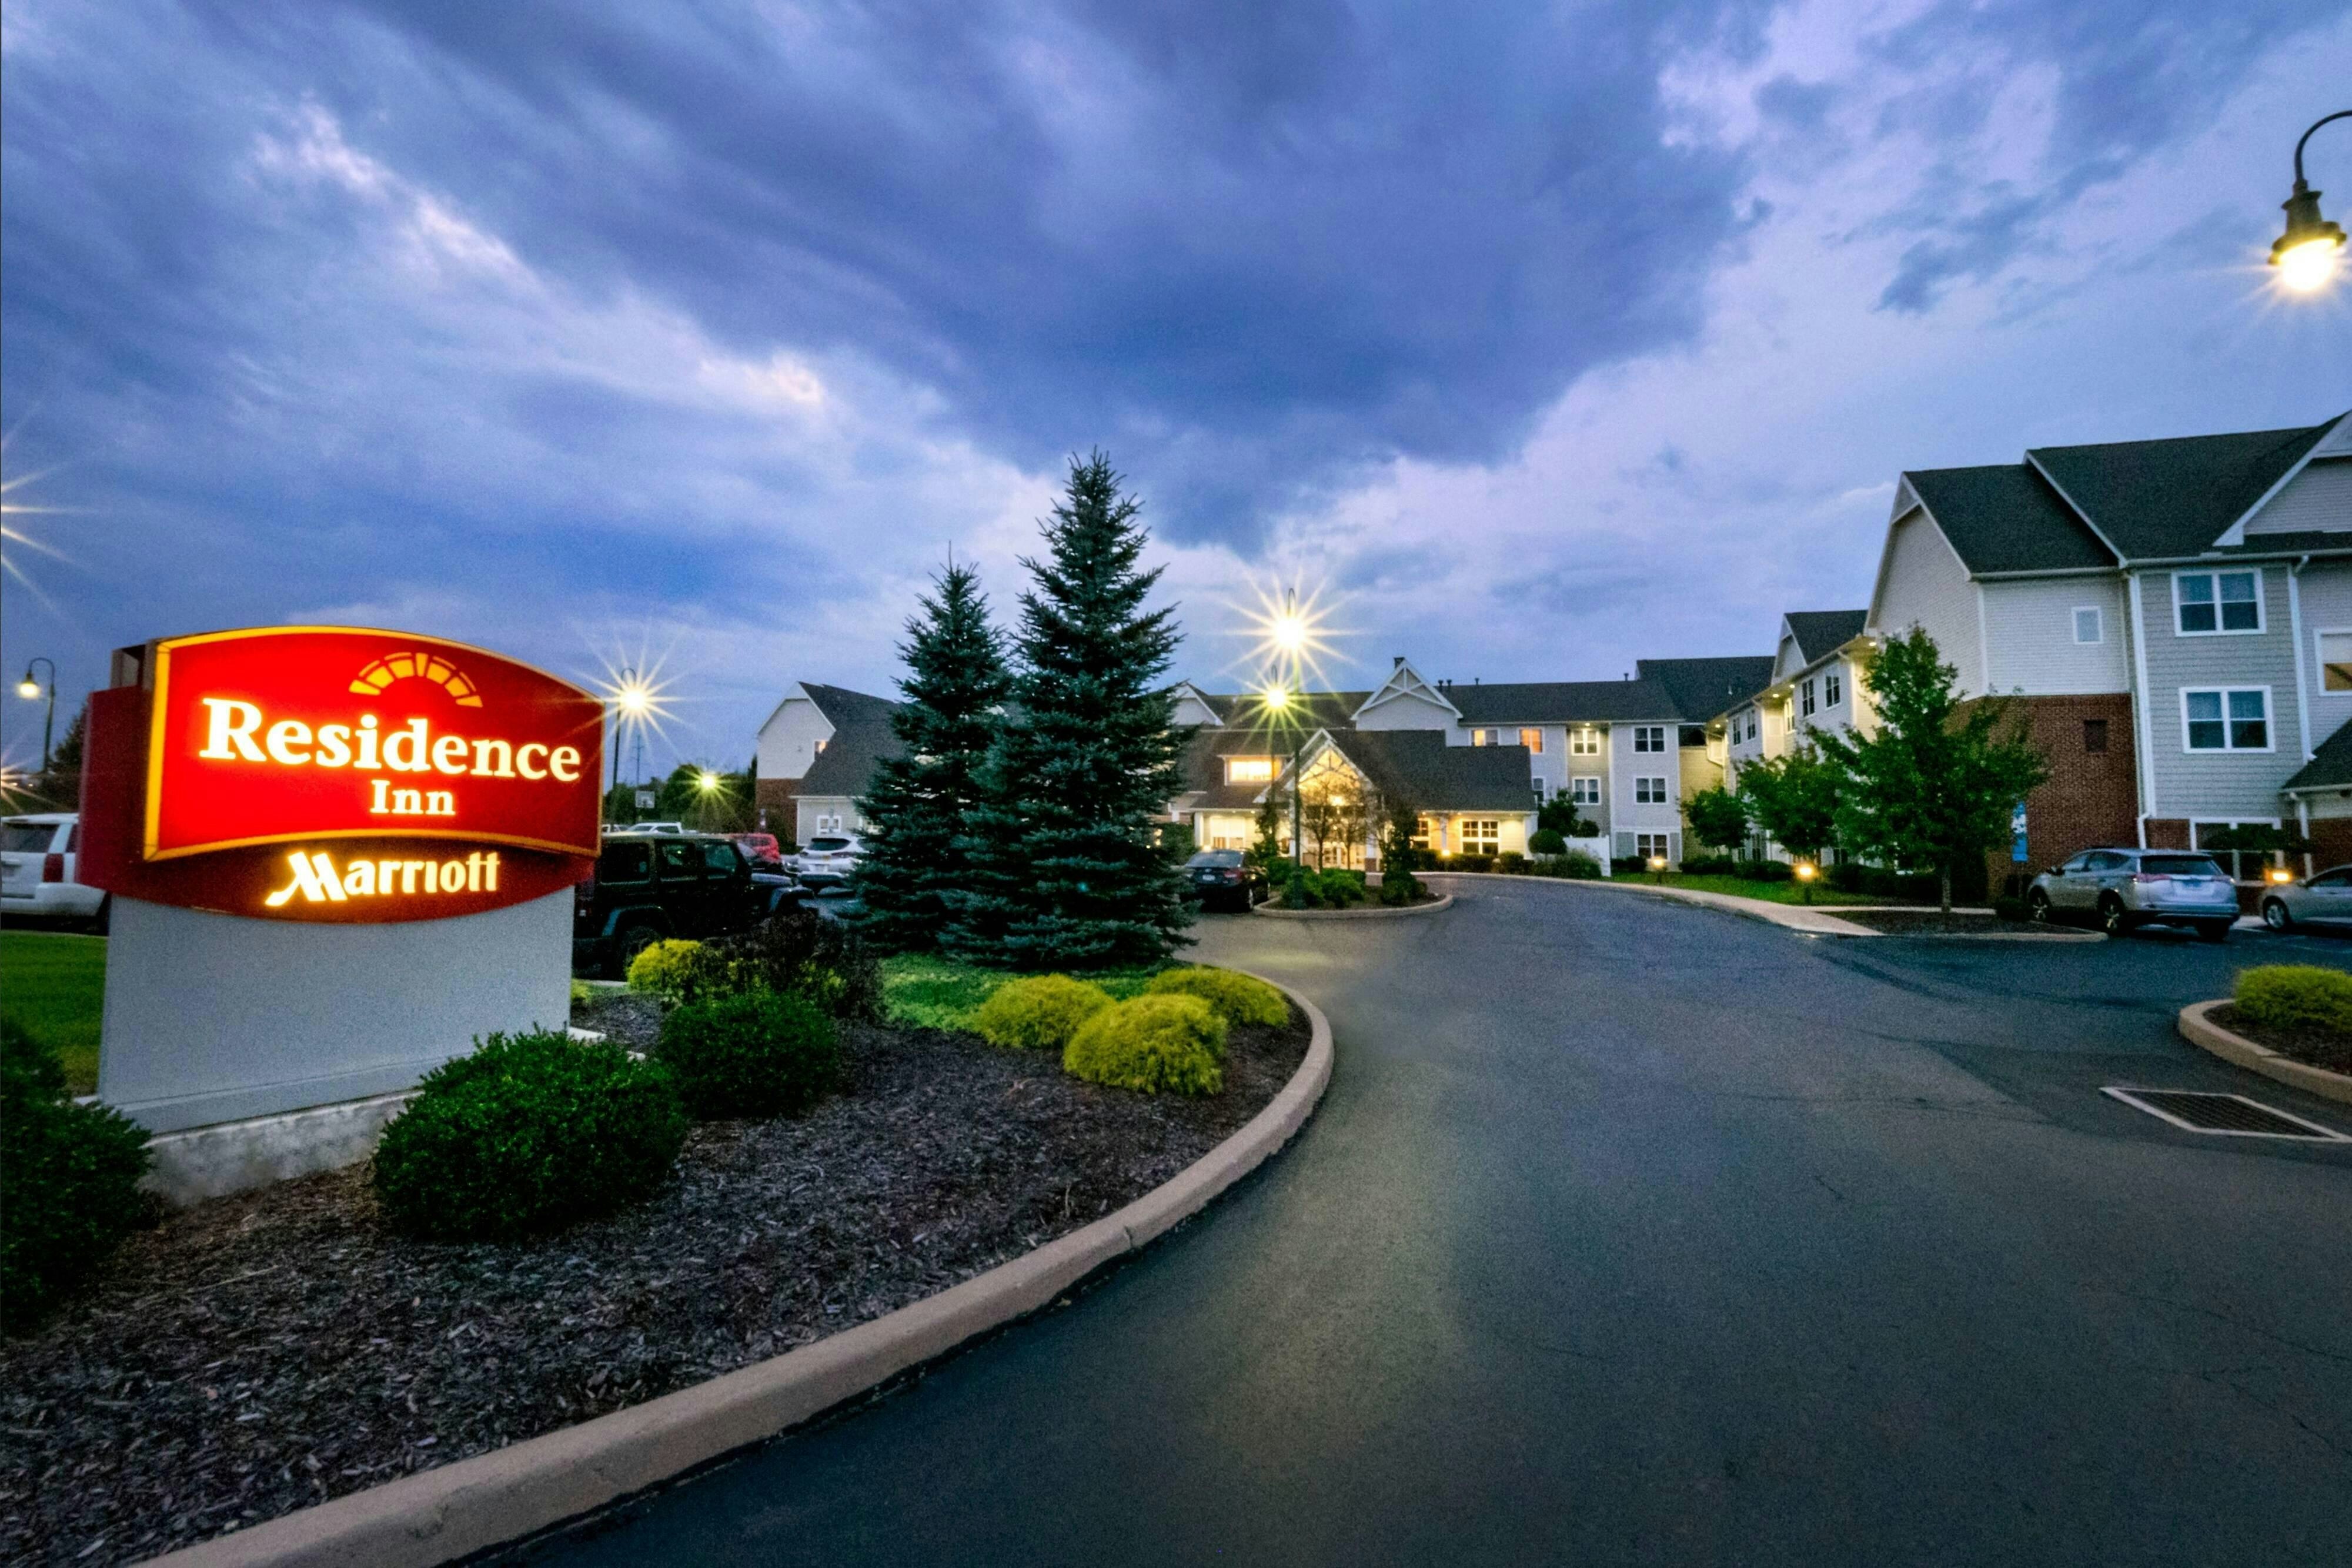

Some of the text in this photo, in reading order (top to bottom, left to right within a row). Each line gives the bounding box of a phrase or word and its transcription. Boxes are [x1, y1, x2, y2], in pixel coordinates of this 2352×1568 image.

[200, 698, 580, 781] Residence
[370, 780, 455, 815] Inn
[265, 851, 500, 906] Marriott
